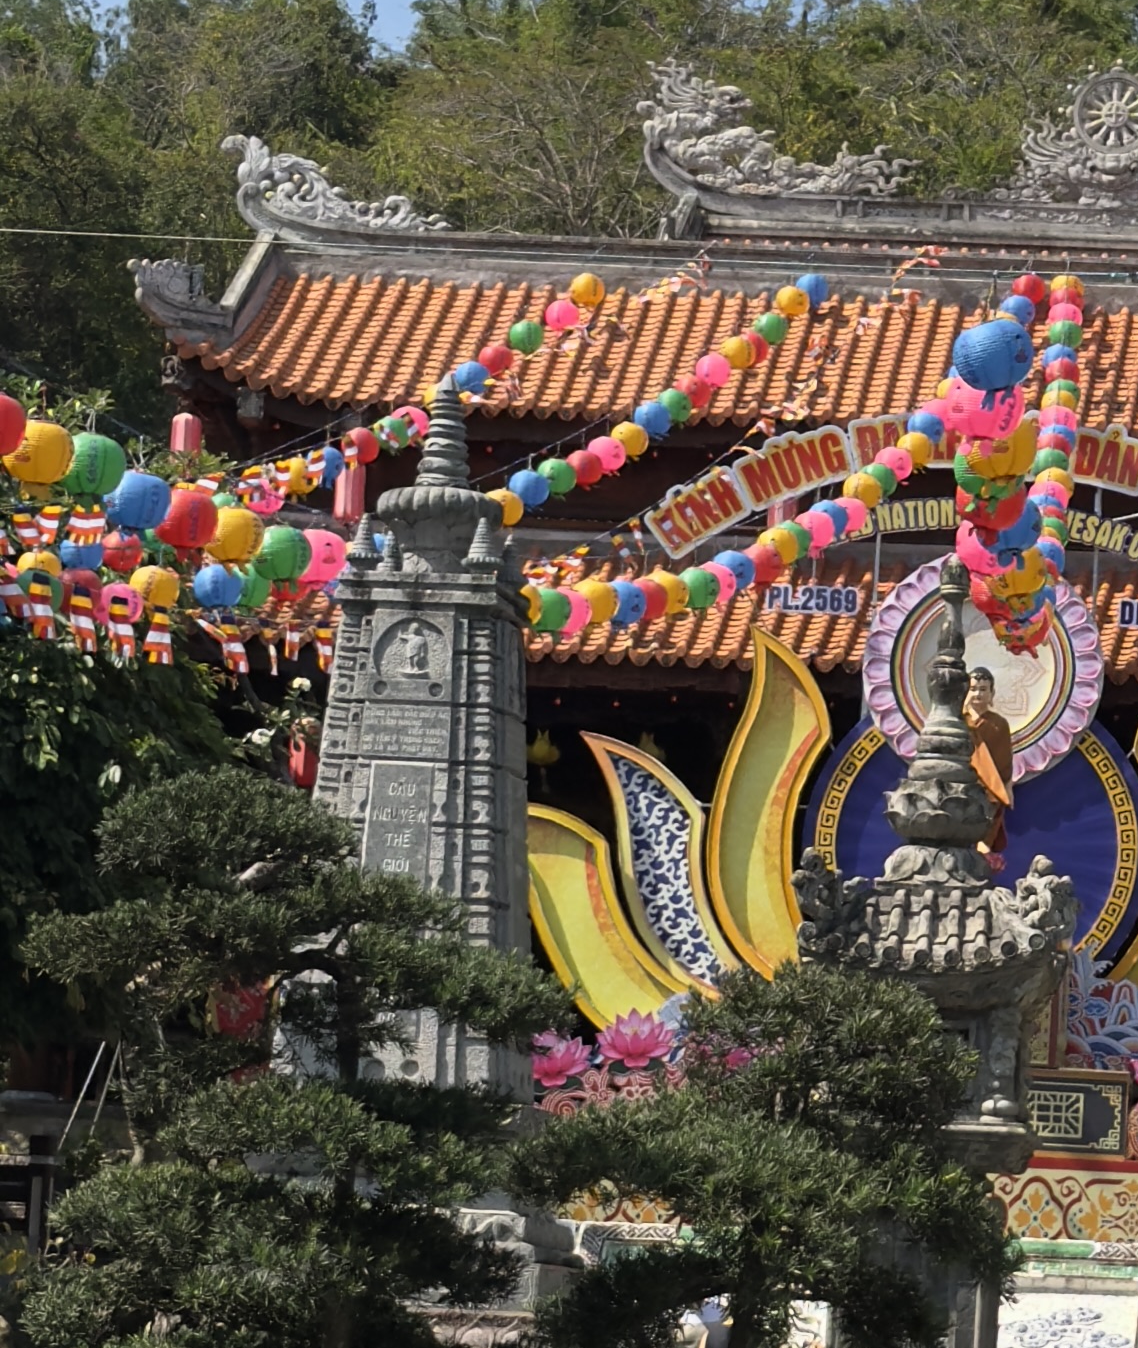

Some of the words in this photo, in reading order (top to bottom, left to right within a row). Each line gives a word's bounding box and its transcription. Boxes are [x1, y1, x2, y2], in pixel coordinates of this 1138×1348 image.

[741, 433, 848, 503] MỪNG
[876, 499, 961, 532] NATION
[767, 586, 857, 612] PL.2569
